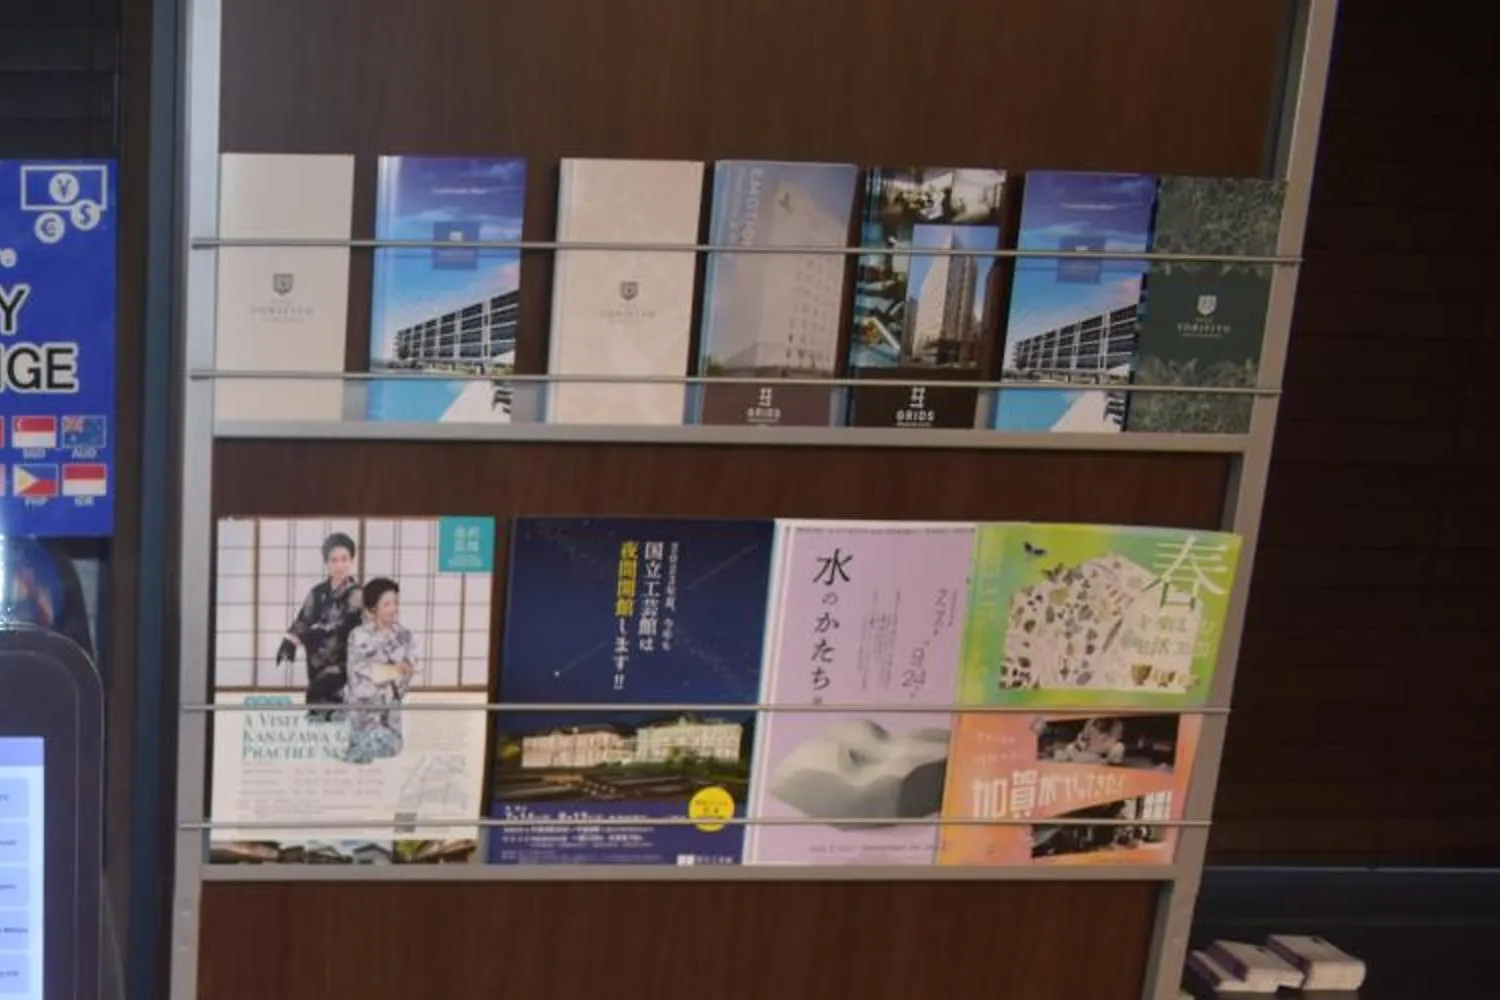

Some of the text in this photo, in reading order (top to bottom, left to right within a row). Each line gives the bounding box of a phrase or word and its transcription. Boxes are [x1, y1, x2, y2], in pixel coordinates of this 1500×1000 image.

[811, 547, 854, 692] 水のかたち
